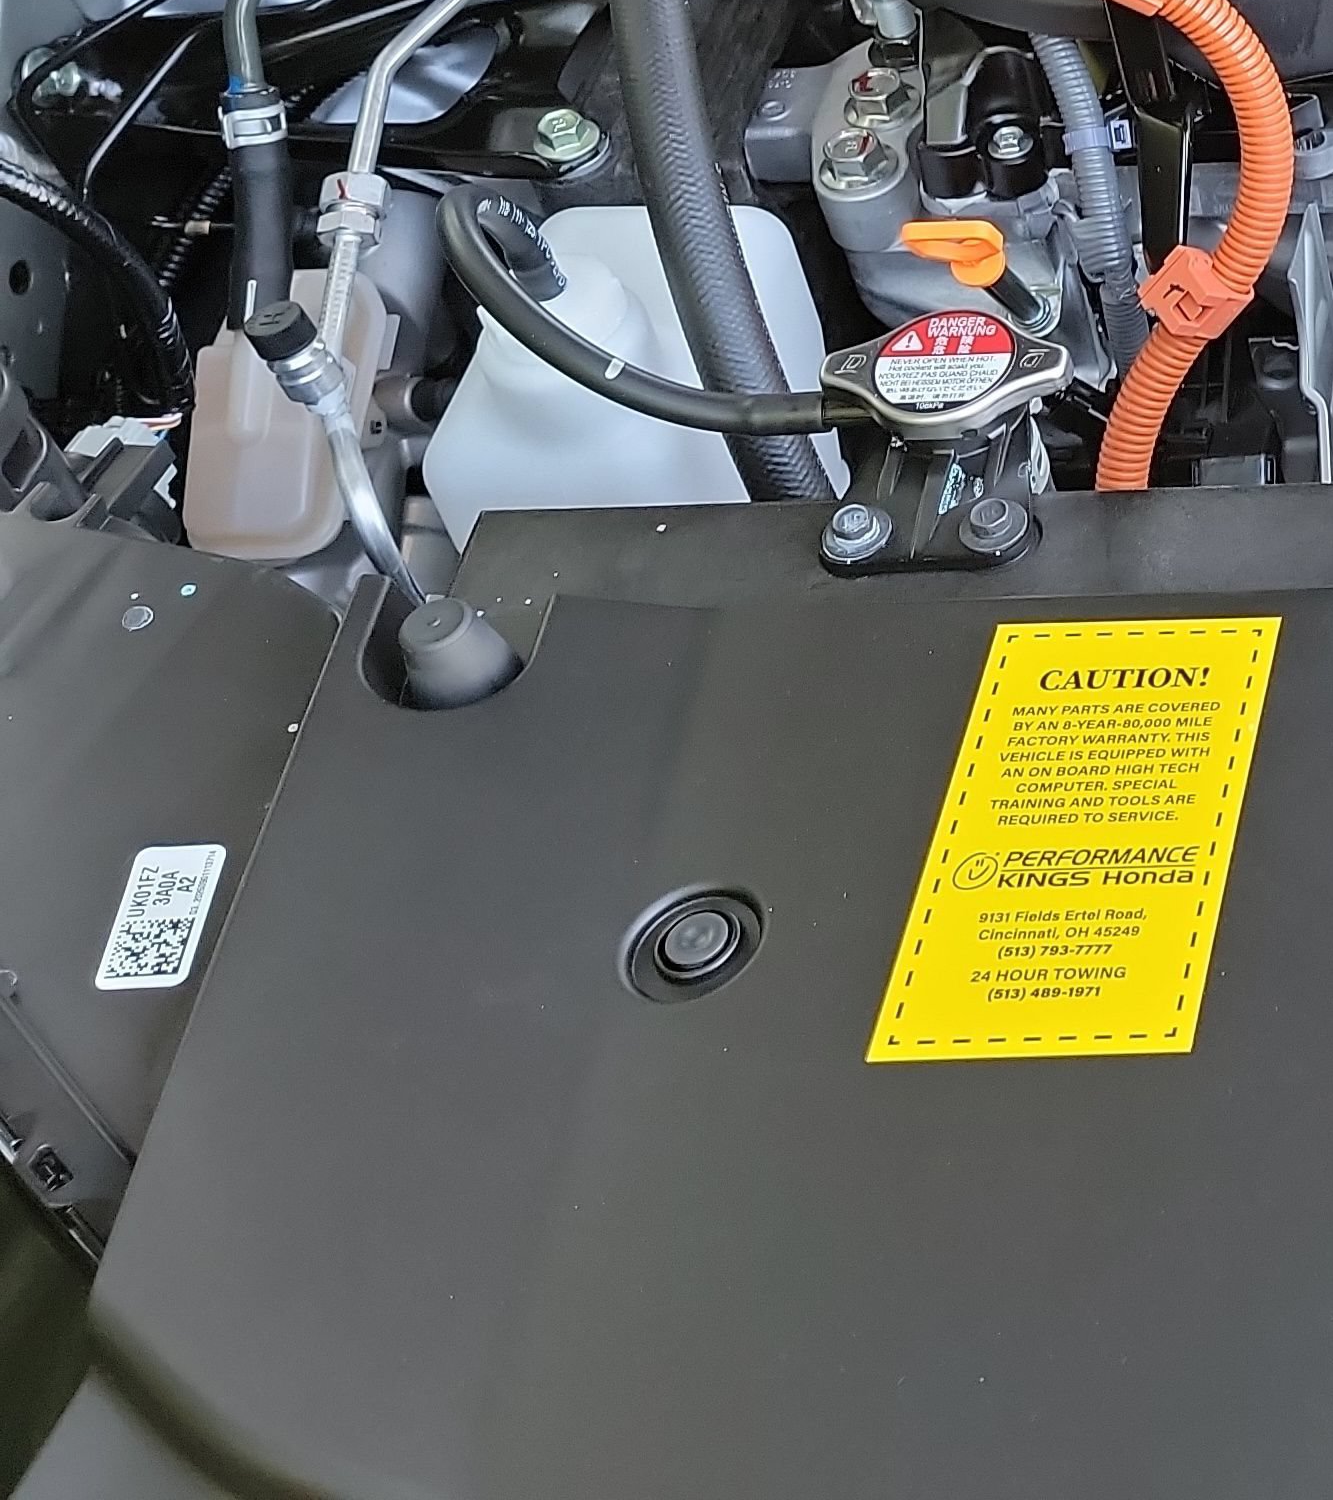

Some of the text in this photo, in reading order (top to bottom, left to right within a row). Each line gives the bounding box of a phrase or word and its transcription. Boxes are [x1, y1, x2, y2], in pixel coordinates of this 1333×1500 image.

[929, 317, 986, 328] DANGER
[928, 325, 996, 337] WARNUNG
[1039, 667, 1210, 691] CAUTION!
[1012, 701, 1220, 716] MANY PARTS ARE COVERED
[1013, 717, 1212, 731] BY AN 8-YEAR-80,000 MILE
[1007, 732, 1210, 746] FACTORY WARRANTY. THIS
[1000, 747, 1210, 762] VEHICLE IS EQUIPPED WITH
[1001, 763, 1200, 778] AN ON BOARD HIGH TECH
[1016, 779, 1177, 794] COMPUTER. SPECIAL
[991, 794, 1196, 810] TRAINING AND TOOLS ARE
[998, 811, 1179, 826] REQUIRED TO SERVICE.
[1003, 845, 1201, 867] PERFORMANCE
[177, 876, 197, 893] A2
[997, 869, 1194, 888] KINGS Honda
[127, 866, 160, 918] UK01FZ
[152, 870, 180, 906] 3A0A
[979, 908, 1147, 923] 9131 Fields Ertel Road,
[979, 926, 1140, 941] Cincinnati, OH 45249
[998, 944, 1113, 959] (513) 793-7777
[970, 967, 1127, 982] 24 HOUR TOWING
[988, 986, 1101, 1002] (513) 489-1971
